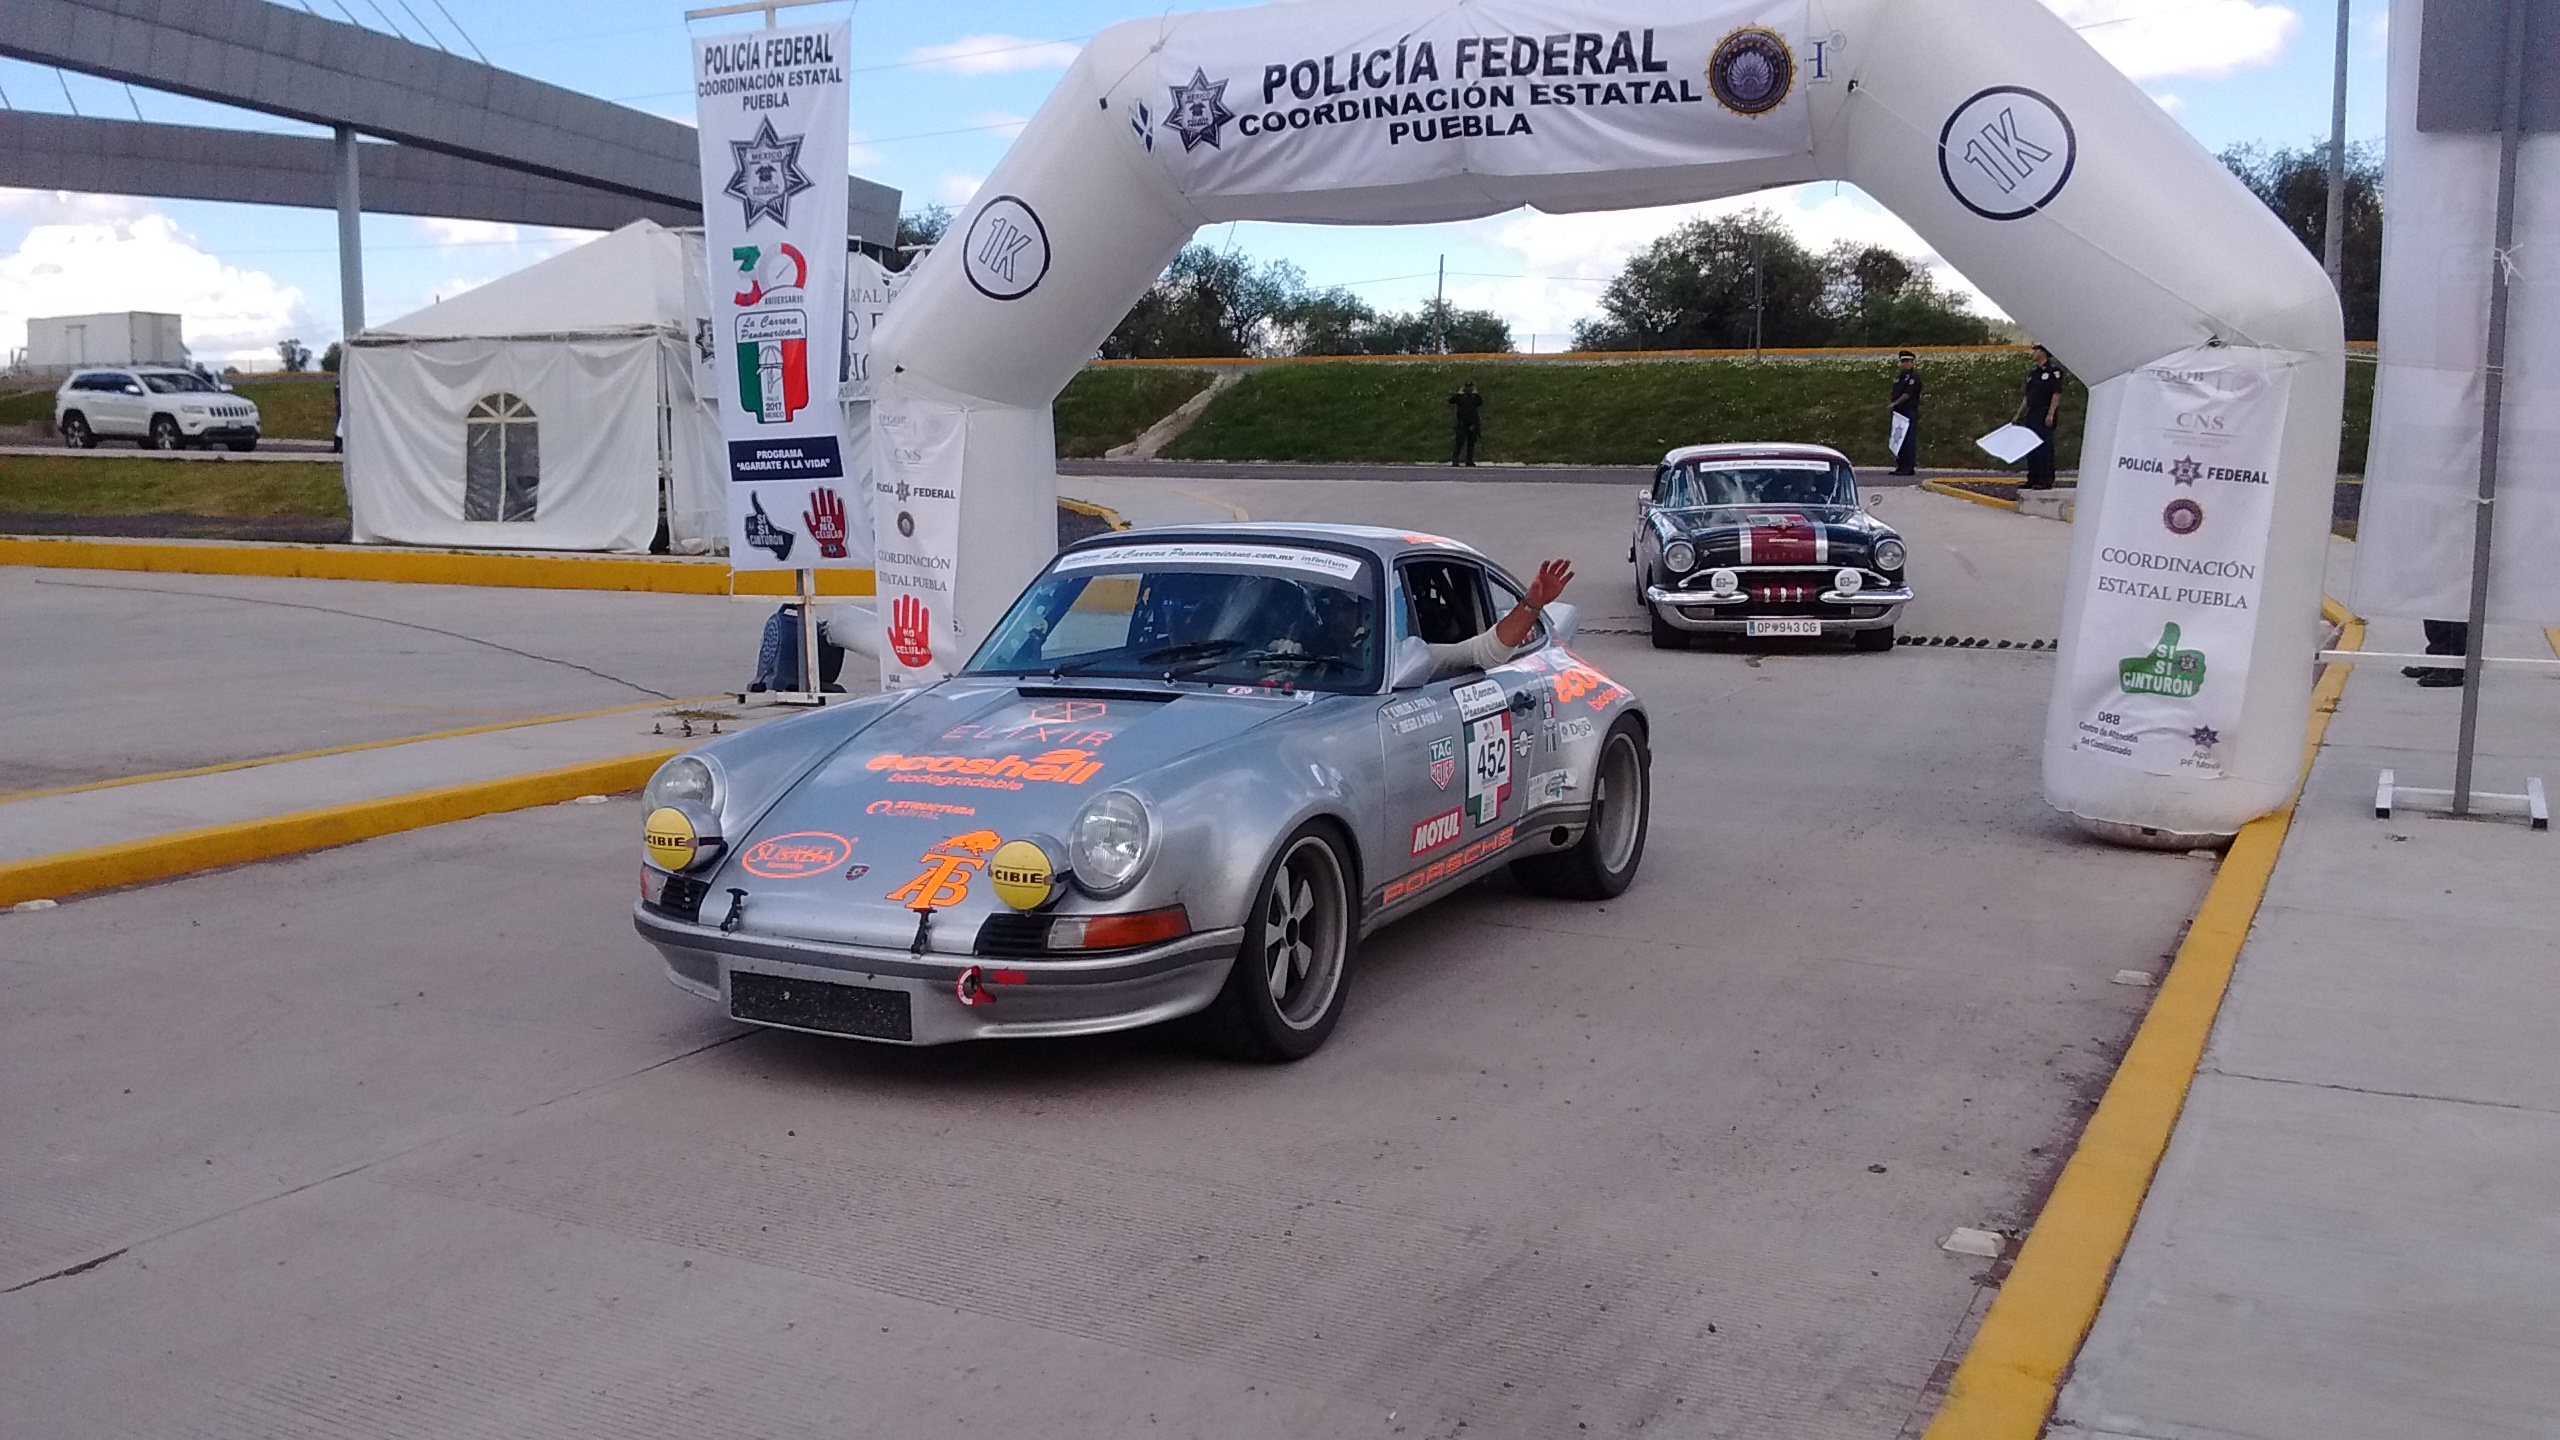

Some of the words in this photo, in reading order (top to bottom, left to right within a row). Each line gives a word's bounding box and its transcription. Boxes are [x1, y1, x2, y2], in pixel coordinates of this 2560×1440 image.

[704, 34, 761, 77] POLICÍA
[765, 33, 834, 69] FEDERAL
[1262, 33, 1439, 105] POLICÍA
[1456, 28, 1668, 80] FEDERAL
[698, 70, 785, 98] COORDINACIÓN
[788, 67, 843, 87] ESTATAL
[742, 92, 790, 111] PUEBLA
[1239, 82, 1514, 136] COORDINACIÓN
[1530, 79, 1702, 106] ESTATAL
[1389, 113, 1534, 145] PUEBLA
[742, 316, 755, 328] La
[760, 315, 798, 329] Carrera
[765, 402, 782, 411] 2017
[2176, 412, 2224, 430] CNS
[756, 449, 803, 459] PROGRAMA
[894, 448, 922, 461] CNS
[791, 460, 803, 468] LA
[2118, 456, 2164, 474] POLICÍA
[2207, 466, 2269, 485] FEDERAL
[913, 487, 956, 499] FEDERAL
[757, 514, 767, 524] SI
[819, 522, 836, 531] NO
[757, 524, 770, 535] SI
[1104, 550, 1121, 560] La
[1122, 549, 1166, 560] Carrera
[1300, 555, 1349, 570] infinitum
[2101, 547, 2256, 580] COORDINACIÓN
[913, 575, 948, 592] PUEBLA
[2098, 575, 2172, 602] ESTATAL
[2176, 587, 2248, 610] PUEBLA
[1779, 622, 1800, 634] 943
[1802, 621, 1817, 634] CG
[2156, 644, 2175, 660] SI
[2154, 660, 2172, 676] SI
[2122, 671, 2193, 696] CINTURÓN
[1462, 689, 1471, 703] La
[2098, 710, 2121, 726] 088
[942, 724, 1113, 747] ELIXIR
[1430, 740, 1453, 761] TAG
[1477, 737, 1506, 779] 452
[2192, 750, 2211, 760] App
[865, 751, 1105, 785] ecoshell
[2180, 758, 2194, 767] PF
[1431, 760, 1454, 786] HEUER
[646, 834, 686, 847] CIBIE
[1413, 811, 1460, 854] MOTUL
[1383, 826, 1514, 905] PORSCHE
[995, 869, 1043, 884] CIBIE
